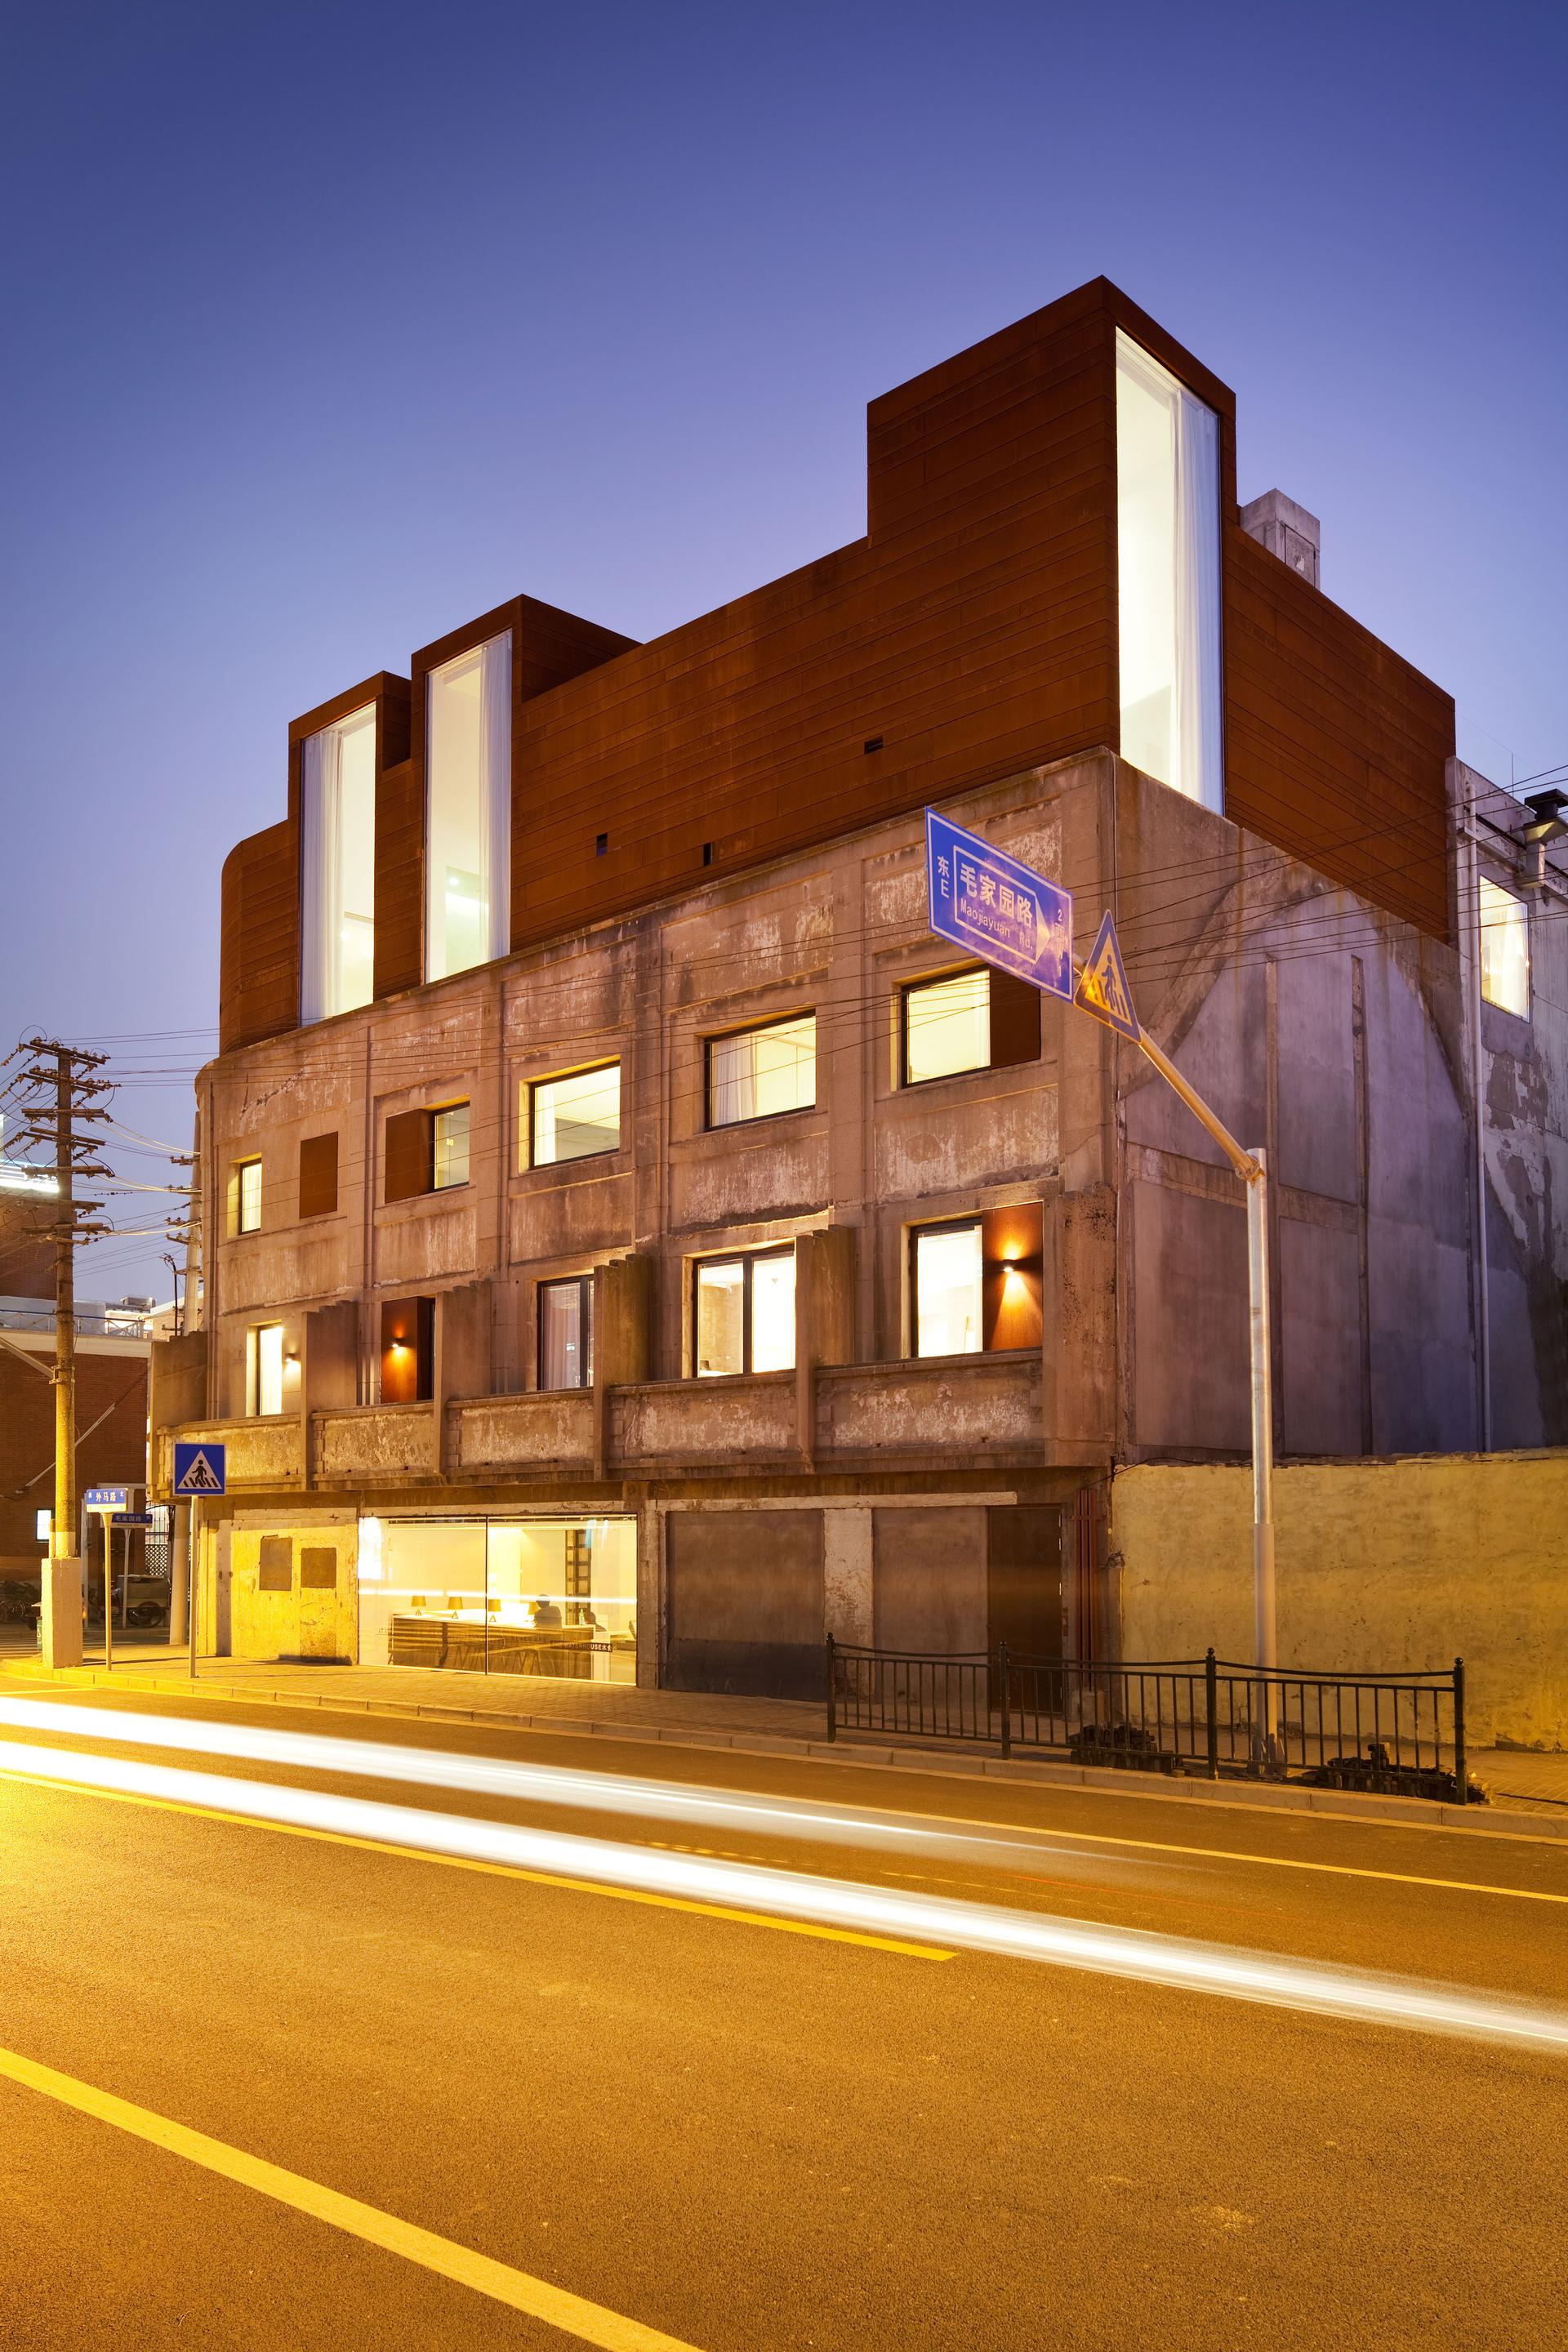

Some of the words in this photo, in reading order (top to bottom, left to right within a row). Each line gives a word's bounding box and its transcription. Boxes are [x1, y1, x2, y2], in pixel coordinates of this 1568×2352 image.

[937, 856, 950, 878] 东
[941, 879, 950, 898] E
[960, 862, 1033, 929] 毛家园路
[960, 898, 1011, 939] Maojiayuan
[1019, 930, 1033, 951] Rd.
[1058, 908, 1062, 922] 2
[96, 1491, 116, 1502] 外马路
